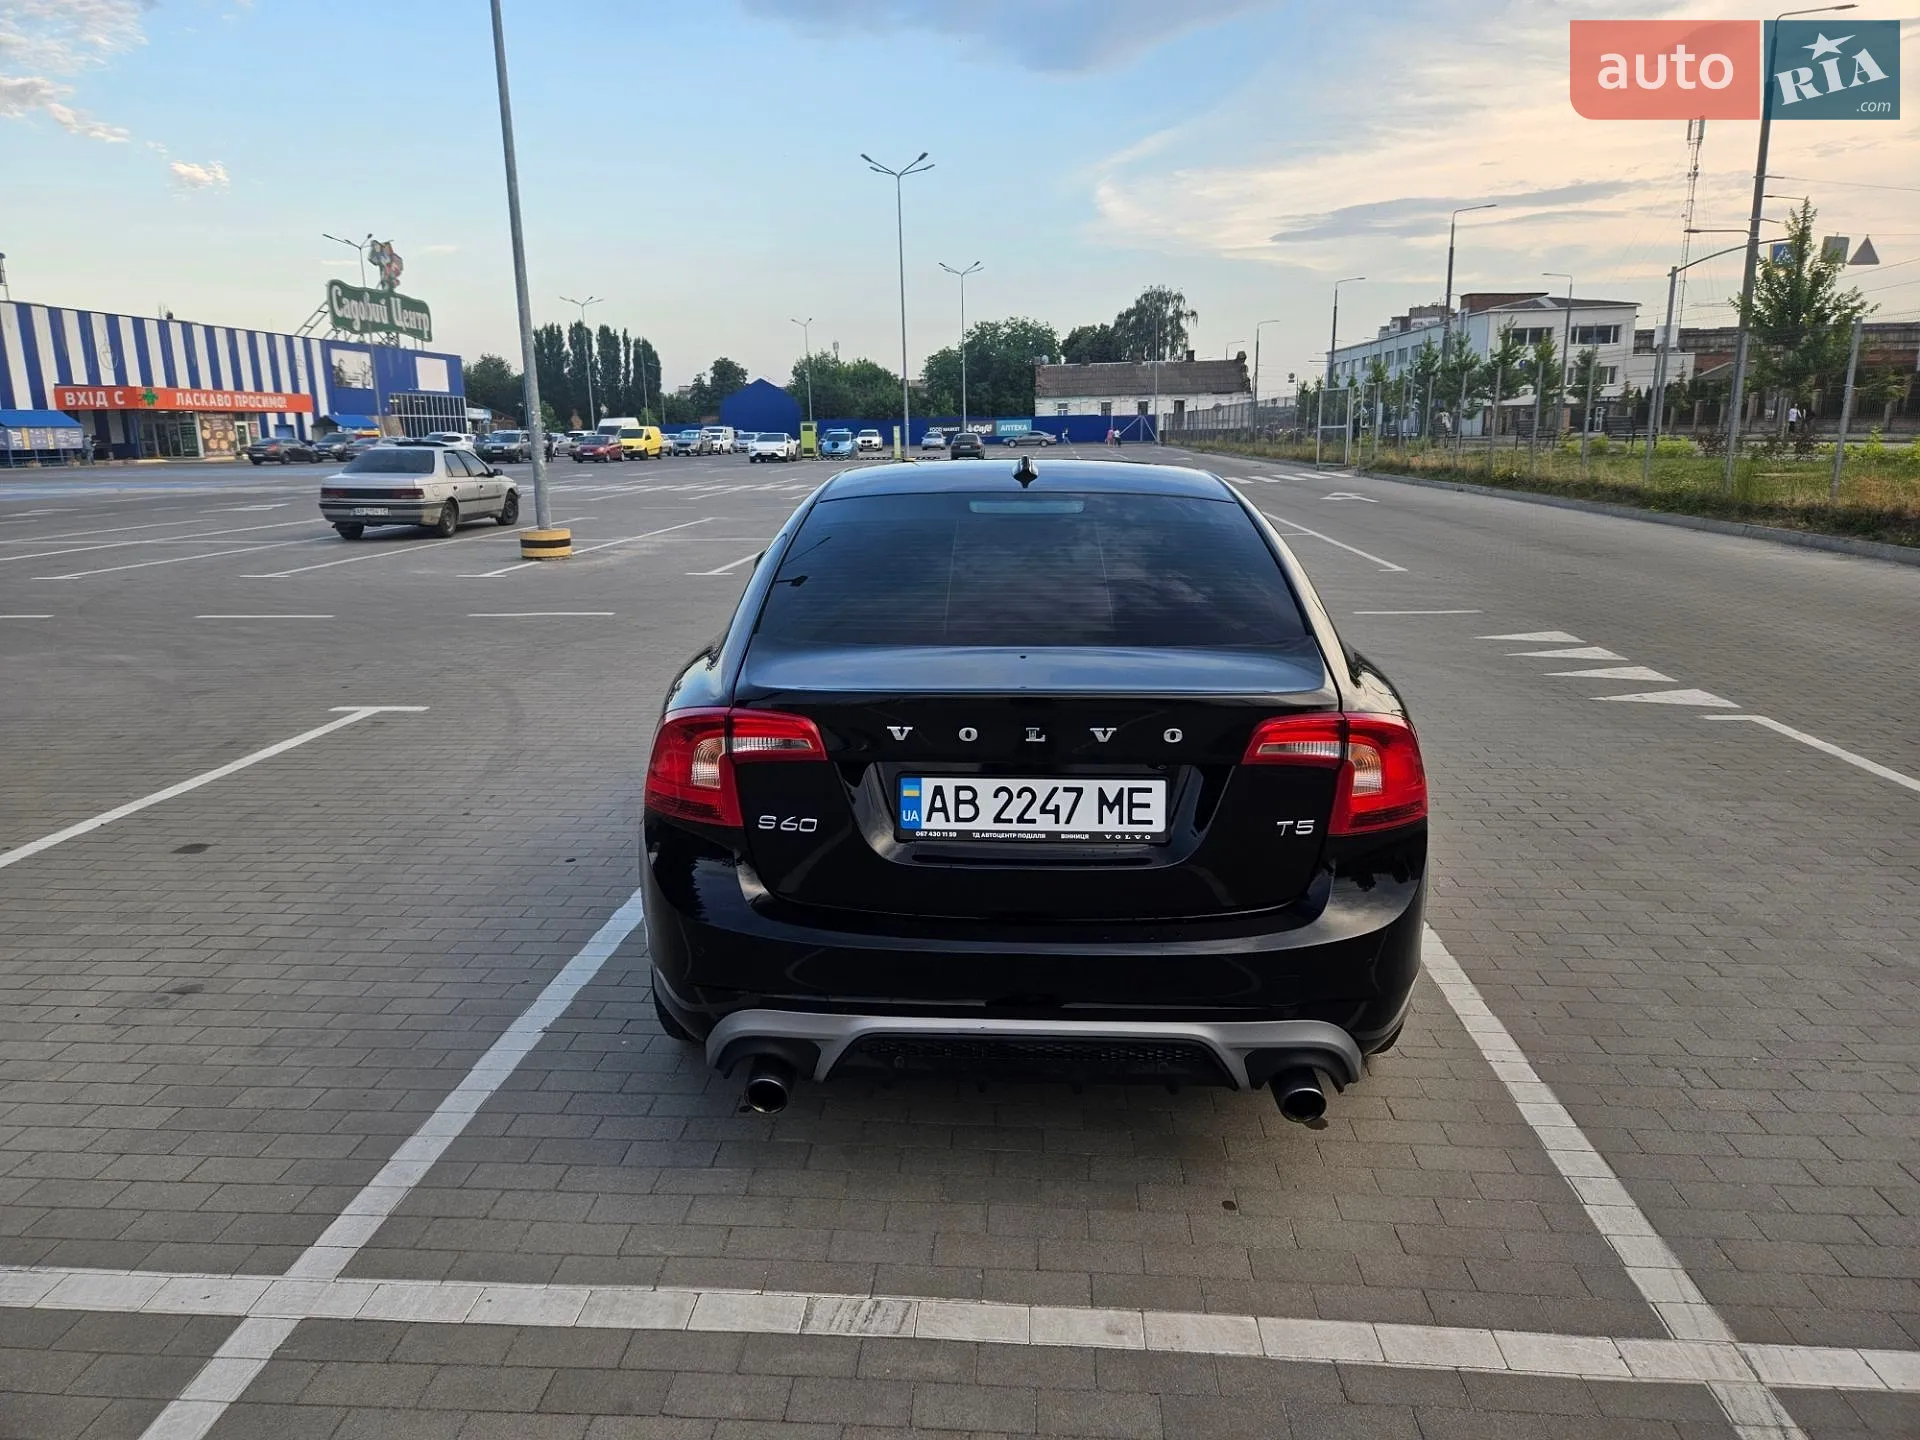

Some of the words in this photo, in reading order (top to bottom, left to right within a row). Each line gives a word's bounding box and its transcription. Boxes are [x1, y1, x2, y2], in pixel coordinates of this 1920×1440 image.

[332, 285, 389, 331] Садовий
[390, 296, 430, 339] Центр
[65, 391, 109, 407] ВХІД
[176, 393, 231, 407] ЛАСКАВО
[234, 394, 288, 409] ПРОСИМО!
[887, 726, 1183, 743] VOLVO
[926, 785, 980, 823] AB
[993, 786, 1084, 825] 2247
[1098, 787, 1154, 825] ME
[758, 815, 818, 832] S60
[903, 811, 919, 822] UA
[1277, 819, 1315, 837] T5
